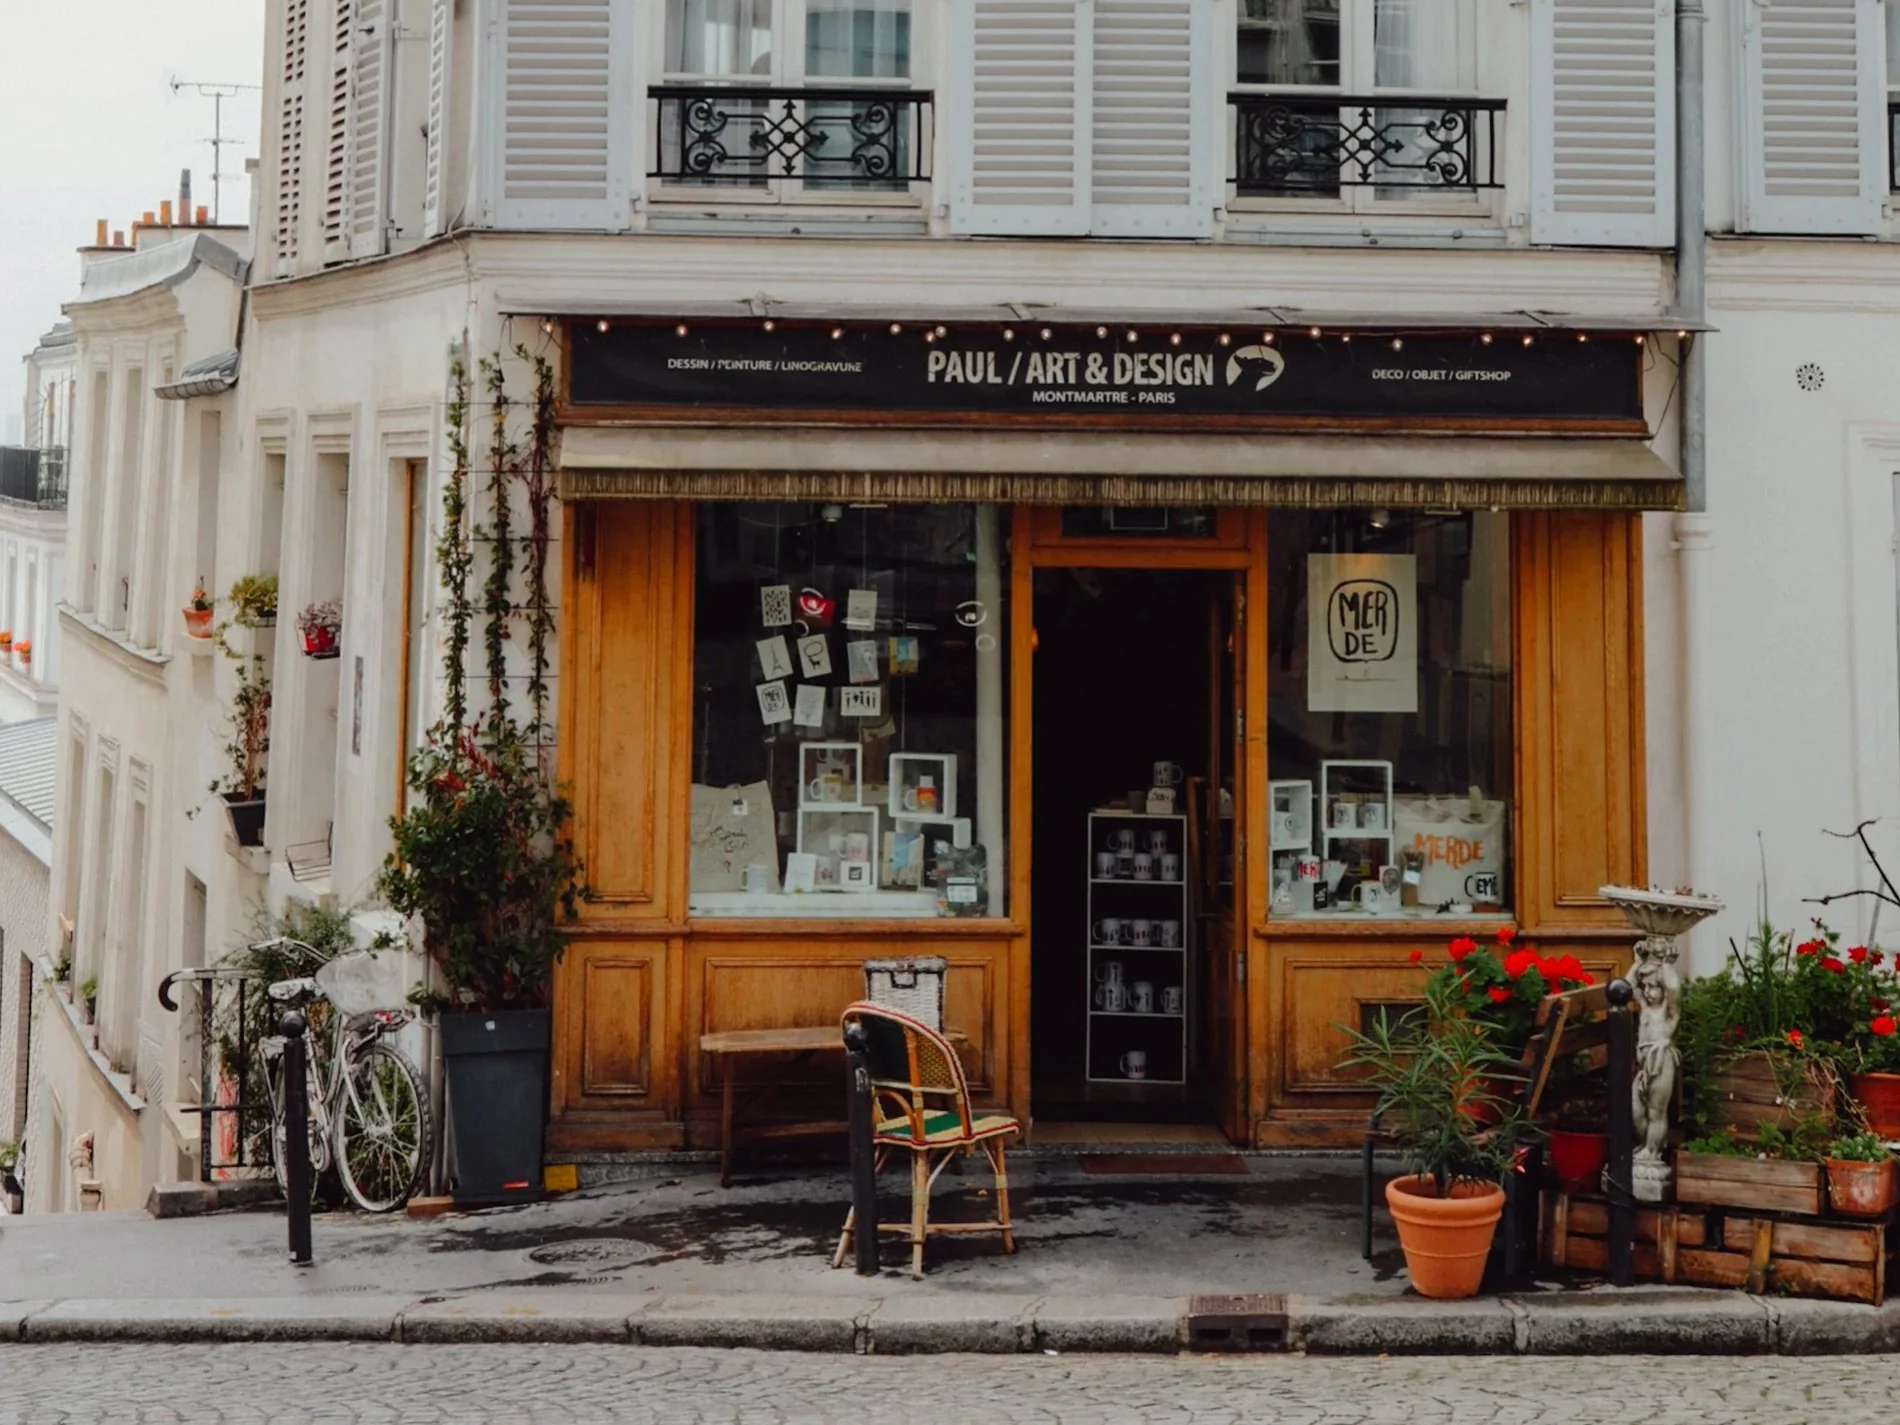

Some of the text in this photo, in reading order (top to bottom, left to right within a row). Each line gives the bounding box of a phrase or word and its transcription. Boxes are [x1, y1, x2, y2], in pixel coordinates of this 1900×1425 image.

[668, 358, 709, 370] DESSIN
[717, 359, 773, 371] PEINTURE
[781, 361, 863, 373] LINOGRAVURE
[927, 350, 1003, 385] PAUL
[1025, 351, 1081, 385] ART
[1084, 352, 1109, 385] &
[1113, 353, 1214, 386] DESIGN
[1371, 369, 1404, 380] DECO
[1412, 369, 1447, 381] OBJET
[1455, 370, 1512, 382] GIFTSHOP
[1032, 390, 1129, 404] MONTMARTRE
[1138, 391, 1176, 404] PARIS
[1339, 590, 1389, 637] MER
[1344, 631, 1379, 657] DE
[1413, 831, 1484, 872] MERDE
